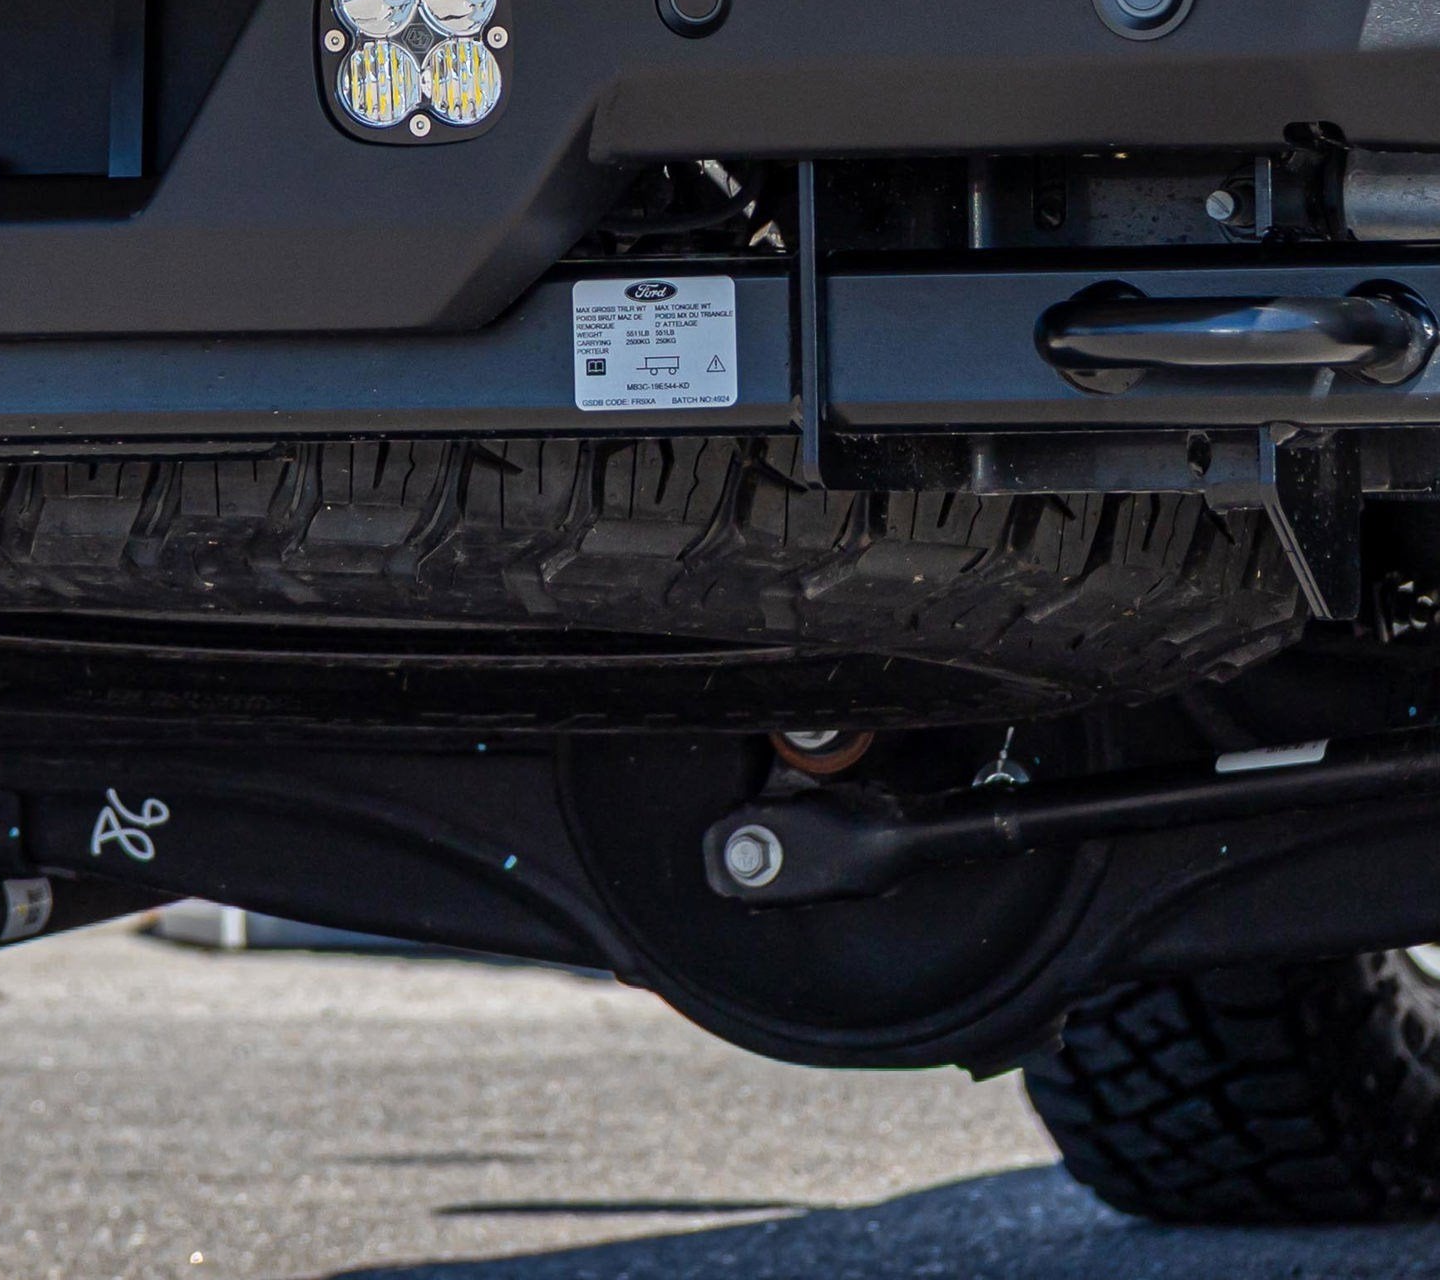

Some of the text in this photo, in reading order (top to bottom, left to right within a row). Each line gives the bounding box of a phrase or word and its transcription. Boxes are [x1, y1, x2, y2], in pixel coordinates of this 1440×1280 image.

[635, 283, 667, 299] Ford
[700, 310, 733, 318] TRIANGLE
[582, 398, 604, 406] GSDB
[605, 398, 630, 406] CODE:
[671, 396, 698, 405] BATCH
